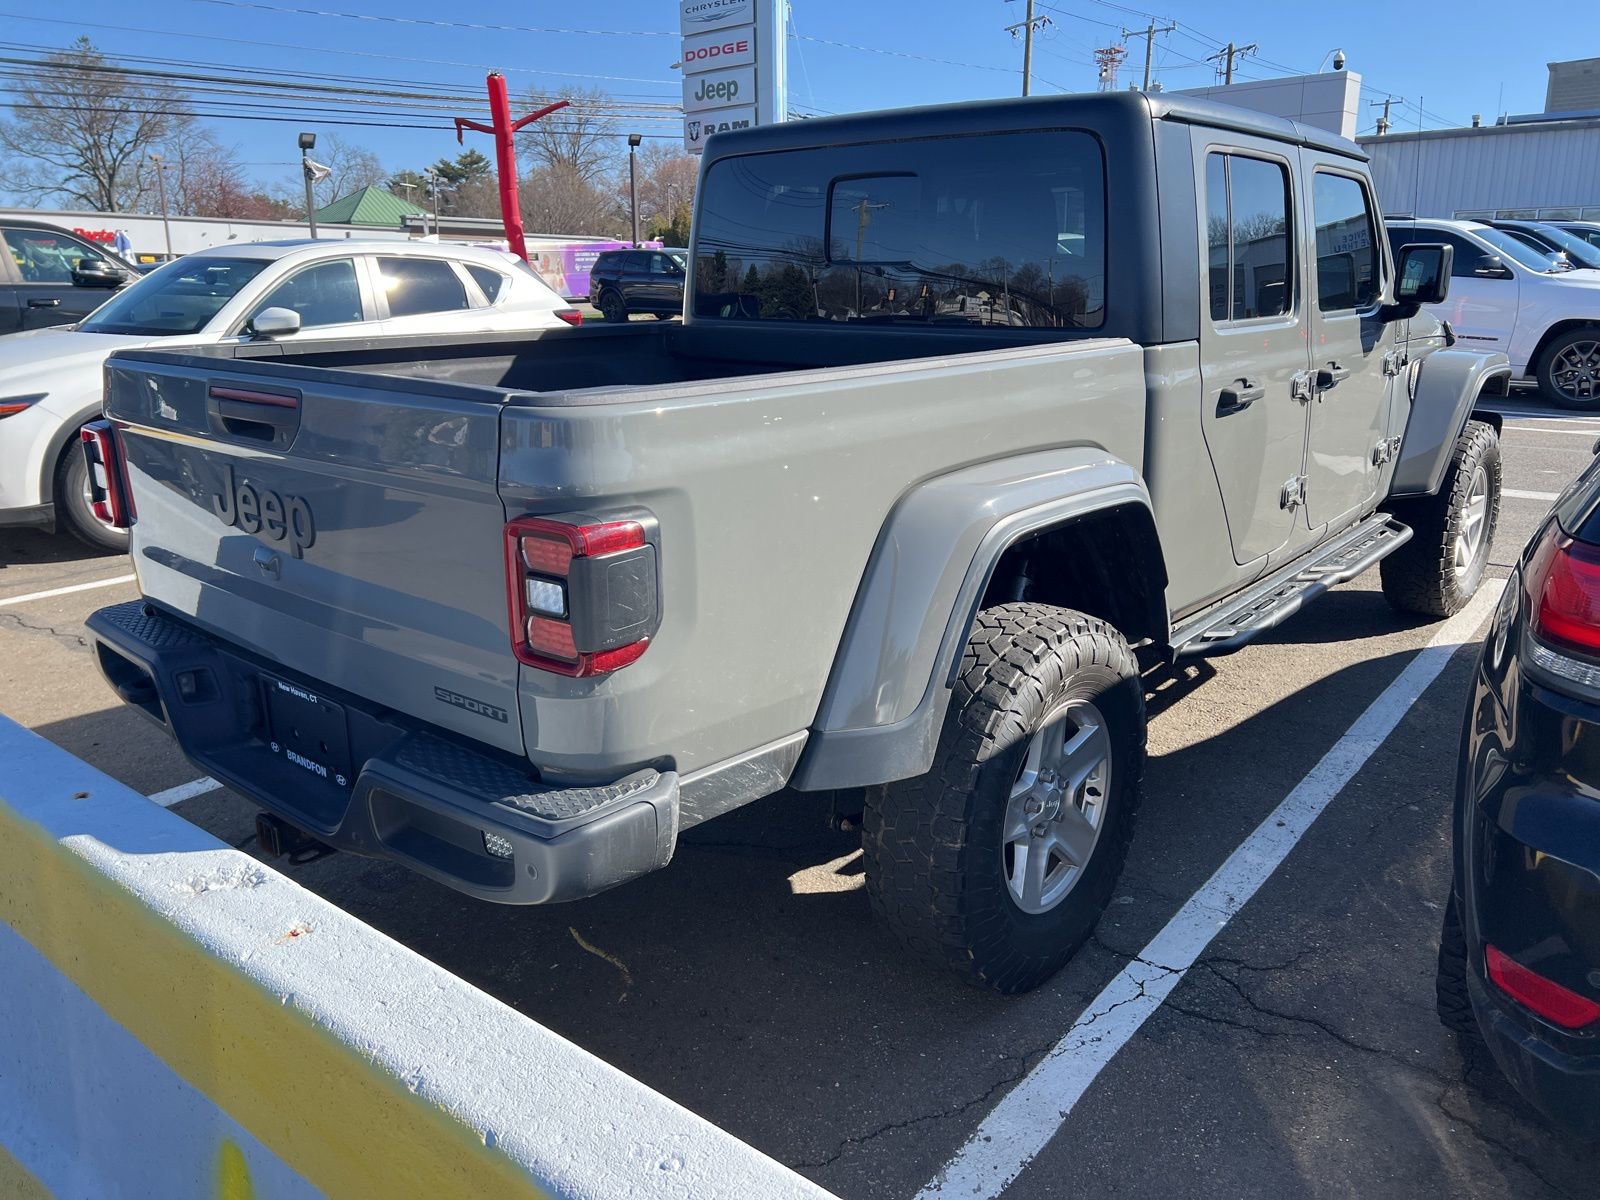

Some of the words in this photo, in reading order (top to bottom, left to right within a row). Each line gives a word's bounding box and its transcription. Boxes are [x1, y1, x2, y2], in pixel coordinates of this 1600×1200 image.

[685, 41, 748, 62] DODGE
[694, 79, 739, 101] Jeep
[704, 120, 749, 135] RAM
[212, 463, 316, 560] Jeep
[278, 682, 290, 692] New
[309, 694, 318, 704] CT
[434, 687, 508, 722] SPORT
[286, 749, 327, 778] BRANDFON
